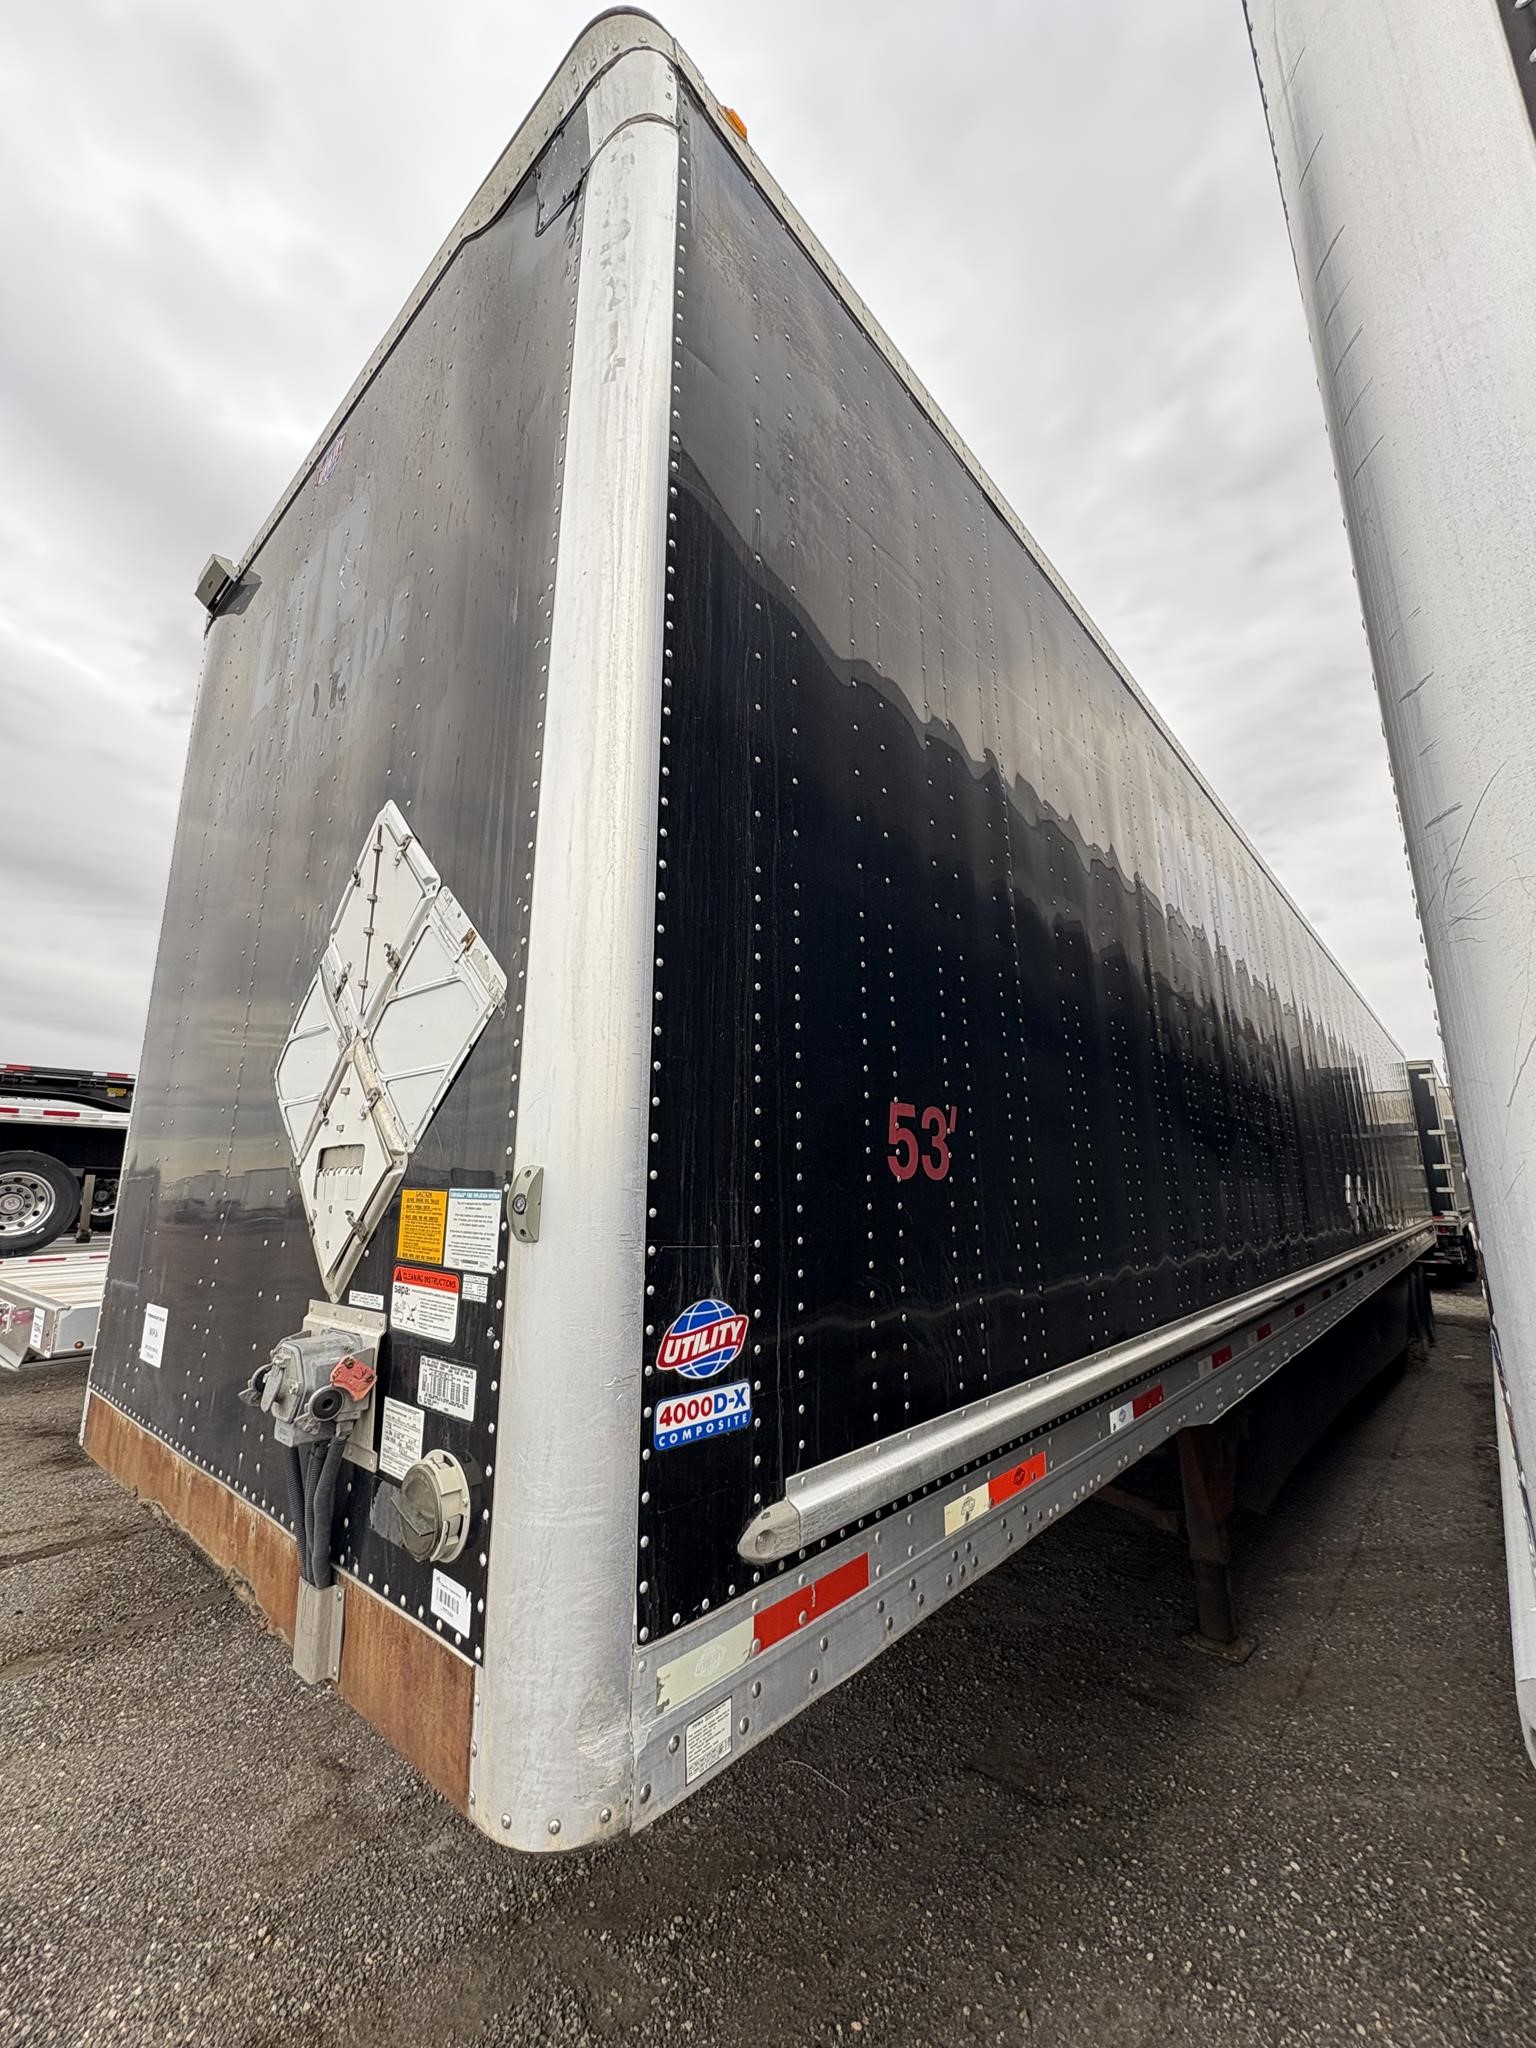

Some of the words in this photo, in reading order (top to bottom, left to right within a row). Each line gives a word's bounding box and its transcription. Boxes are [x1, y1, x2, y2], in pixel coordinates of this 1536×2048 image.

[403, 1272, 424, 1283] CLEANING
[424, 1276, 456, 1289] INSTRUCTIONS
[663, 1320, 744, 1364] UTILITY
[659, 1387, 747, 1427] 4000D-X
[658, 1413, 748, 1447] COMPOSITE
